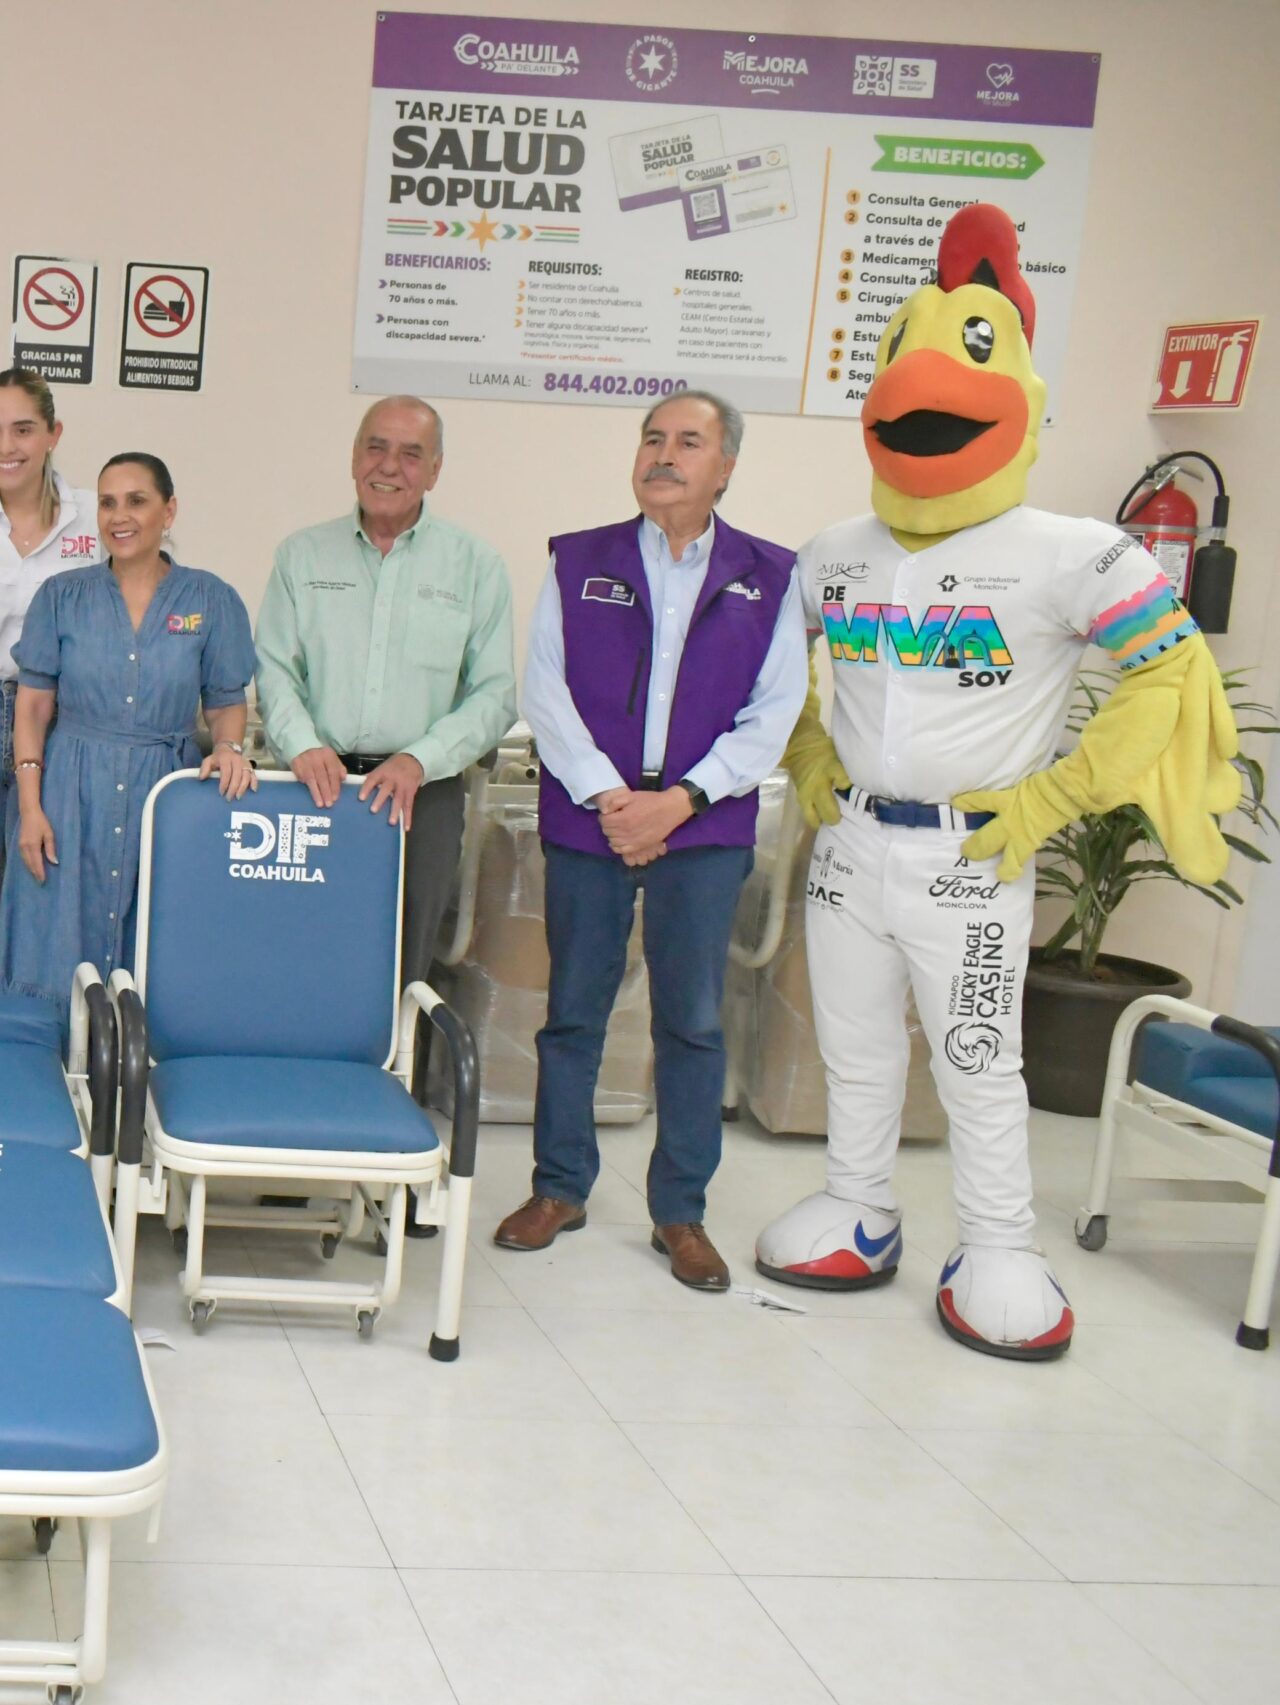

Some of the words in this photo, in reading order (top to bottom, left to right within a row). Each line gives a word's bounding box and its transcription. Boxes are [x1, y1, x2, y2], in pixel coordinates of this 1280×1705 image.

[454, 33, 580, 64] COAHUILA
[643, 34, 674, 49] PASOS
[516, 64, 558, 73] DELANTE
[723, 50, 809, 75] MEJORA
[900, 64, 920, 77] SS
[625, 67, 636, 82] DE
[636, 69, 677, 91] GIGANTE
[739, 74, 795, 87] COAHUILA
[976, 90, 1020, 101] MEJORA
[395, 100, 505, 124] TARJETA
[514, 107, 548, 127] DE
[556, 109, 587, 129] LA
[392, 125, 585, 176] SALUD
[642, 141, 693, 162] SALUD
[893, 146, 1027, 169] BENEFICIOS:
[643, 153, 695, 172] POPULAR
[685, 163, 732, 181] COAHUILA
[389, 174, 581, 213] POPULAR
[868, 193, 925, 208] Consulta
[866, 213, 923, 227] Consulta
[926, 217, 942, 228] de
[864, 235, 871, 244] a
[875, 233, 914, 247] través
[918, 235, 934, 247] de
[384, 253, 491, 271] BENEFICIARIOS:
[528, 260, 602, 276] REQUISITOS:
[1025, 262, 1067, 275] básico
[685, 268, 743, 283] REGISTRO:
[860, 272, 917, 285] Consulta
[389, 280, 432, 290] Personas
[577, 283, 586, 291] de
[683, 288, 711, 297] Centros
[389, 295, 401, 303] 70
[403, 295, 425, 304] años
[682, 301, 717, 310] hospitales
[527, 307, 547, 316] Tener
[549, 308, 558, 316] 70
[559, 309, 576, 317] años
[729, 315, 753, 324] Estatal
[753, 316, 765, 324] del
[387, 315, 429, 326] Personas
[526, 320, 546, 329] Tener
[547, 321, 571, 331] alguna
[573, 322, 619, 333] discapacidad
[386, 331, 446, 341] discapacidad
[680, 326, 702, 334] Adulto
[715, 340, 748, 349] pacientes
[1168, 333, 1219, 353] EXTINTOR
[21, 350, 62, 361] GRACIAS
[64, 353, 83, 363] POR
[124, 356, 159, 369] PROHIBIDO
[160, 358, 198, 371] INTRODUCIR
[41, 366, 81, 378] FUMAR
[126, 372, 162, 384] ALIMENTOS
[163, 374, 168, 384] Y
[168, 374, 194, 386] BEBIDAS
[469, 373, 510, 386] LLAMA
[513, 375, 532, 387] AL:
[543, 372, 688, 396] 844.402.0900
[61, 536, 97, 554] DIF
[819, 561, 870, 575] MRCI
[823, 585, 846, 601] DE
[167, 613, 202, 631] DIF
[822, 602, 1014, 669] MVA
[958, 670, 1012, 688] SOY
[228, 811, 331, 864] DIF
[228, 863, 326, 883] COAHUILA
[807, 881, 844, 906] JAC
[928, 874, 1001, 900] Ford
[936, 901, 988, 910] MONCLOVA
[963, 922, 982, 968] EAGLE
[976, 922, 1004, 1018] CASINO
[948, 975, 960, 1016] KICKAPOO
[957, 971, 978, 1017] LUCKY
[1000, 966, 1015, 1015] HOTEL
